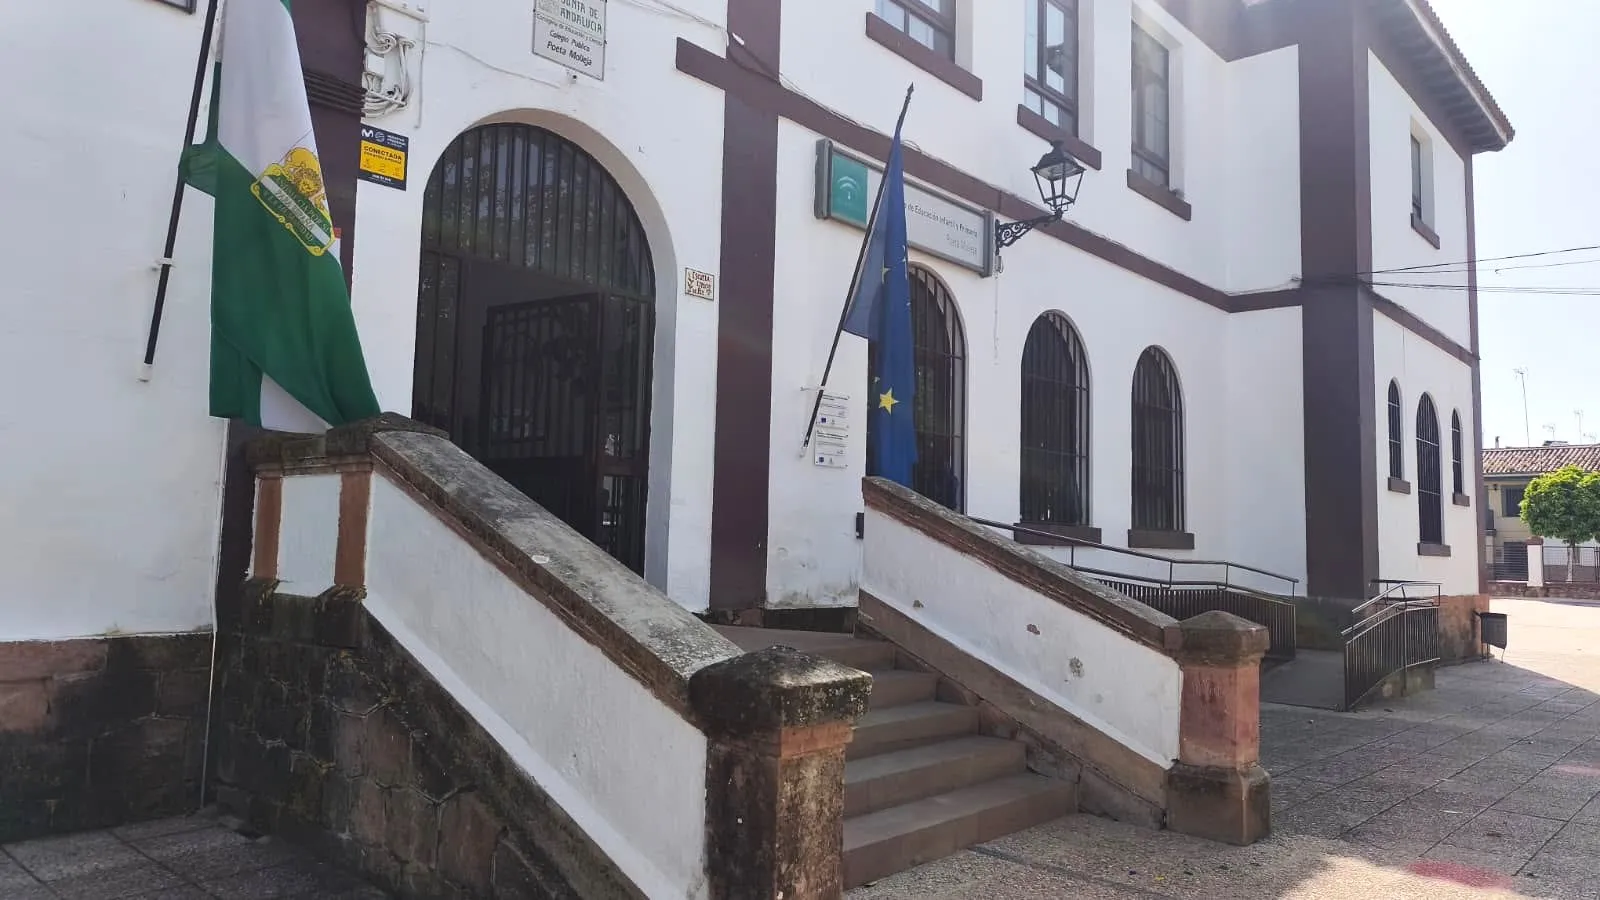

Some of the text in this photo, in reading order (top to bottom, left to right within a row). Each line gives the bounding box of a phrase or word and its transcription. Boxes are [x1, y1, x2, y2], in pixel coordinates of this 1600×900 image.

[589, 7, 600, 20] DE
[547, 40, 567, 55] Poeta
[363, 146, 402, 161] CONECTADA
